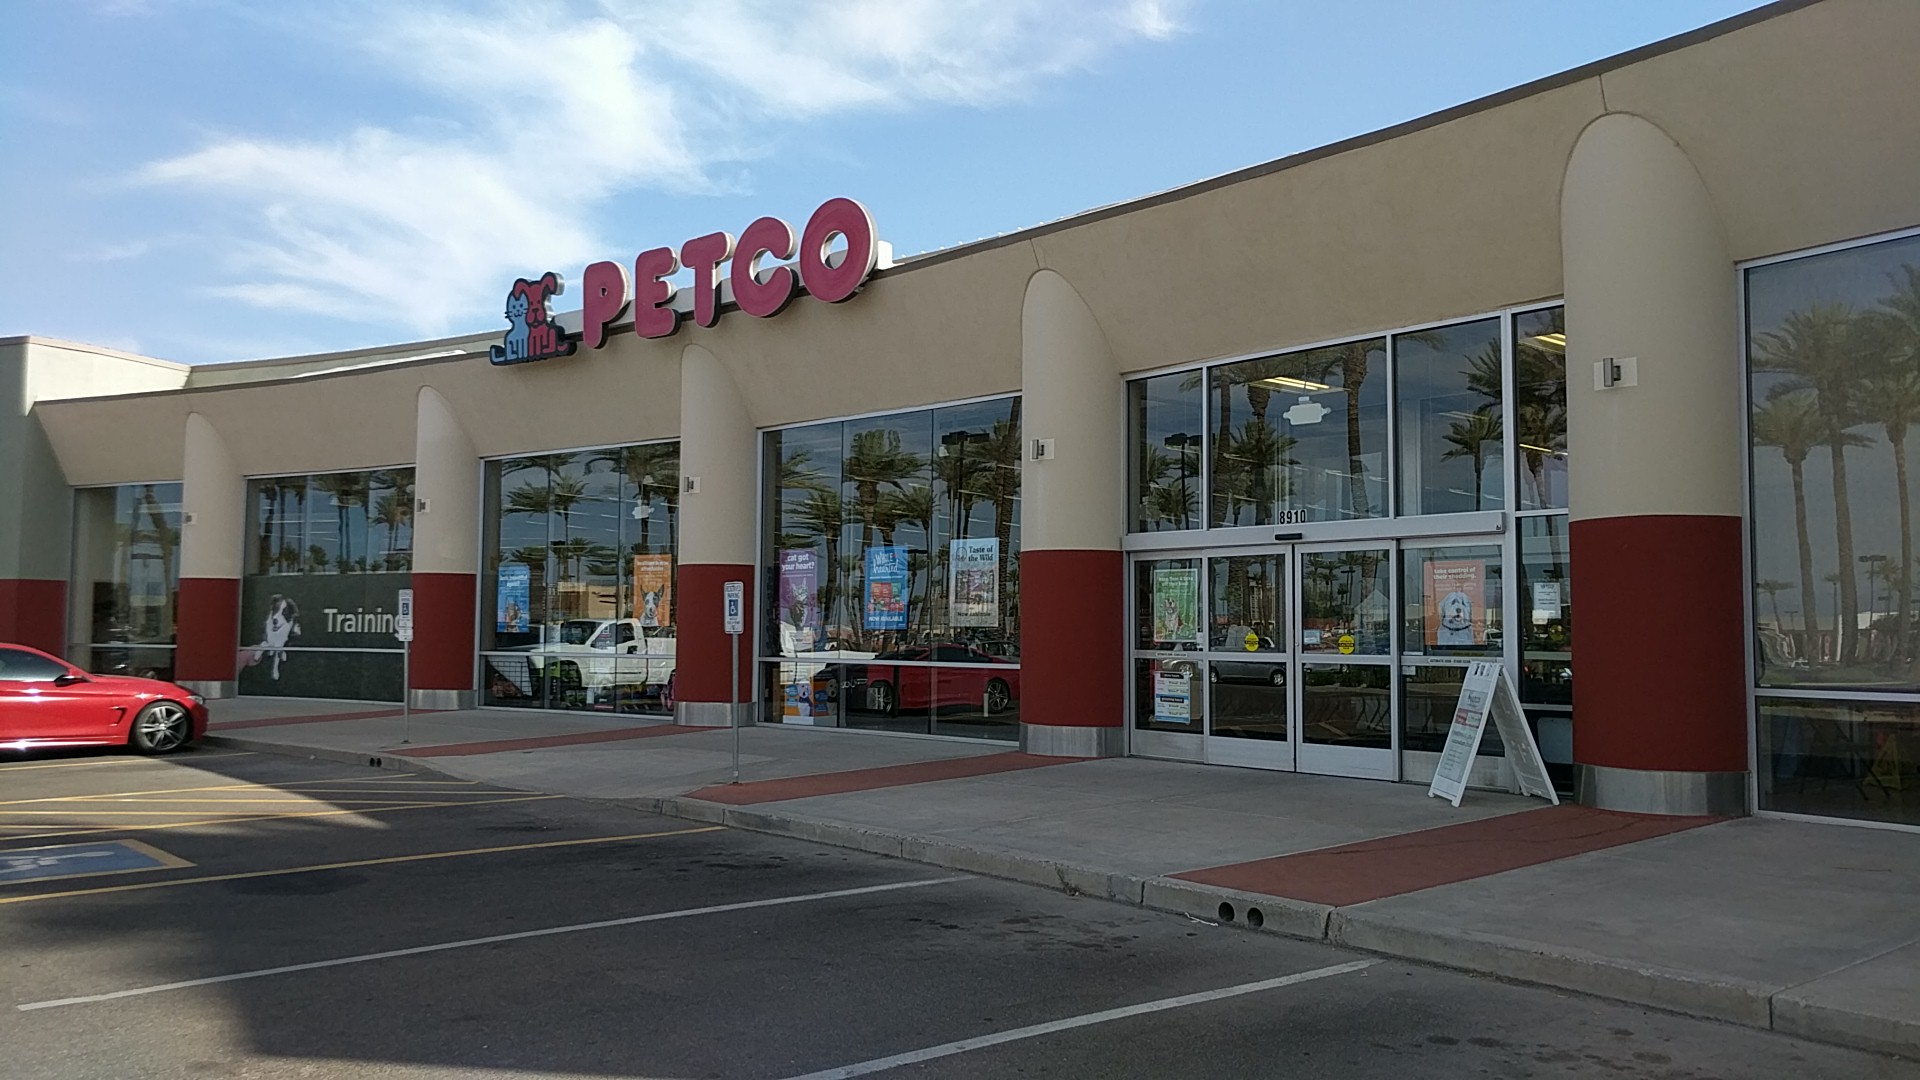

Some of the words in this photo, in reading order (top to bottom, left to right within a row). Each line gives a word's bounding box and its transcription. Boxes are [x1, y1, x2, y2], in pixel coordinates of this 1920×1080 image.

[583, 197, 878, 349] PETCO
[1279, 509, 1306, 525] 8910
[968, 546, 985, 554] Taste
[986, 545, 994, 553] of
[787, 554, 797, 562] cat
[797, 553, 809, 563] got
[968, 554, 978, 562] the
[979, 553, 994, 561] Wild
[781, 564, 796, 572] your
[795, 561, 815, 570] heart?
